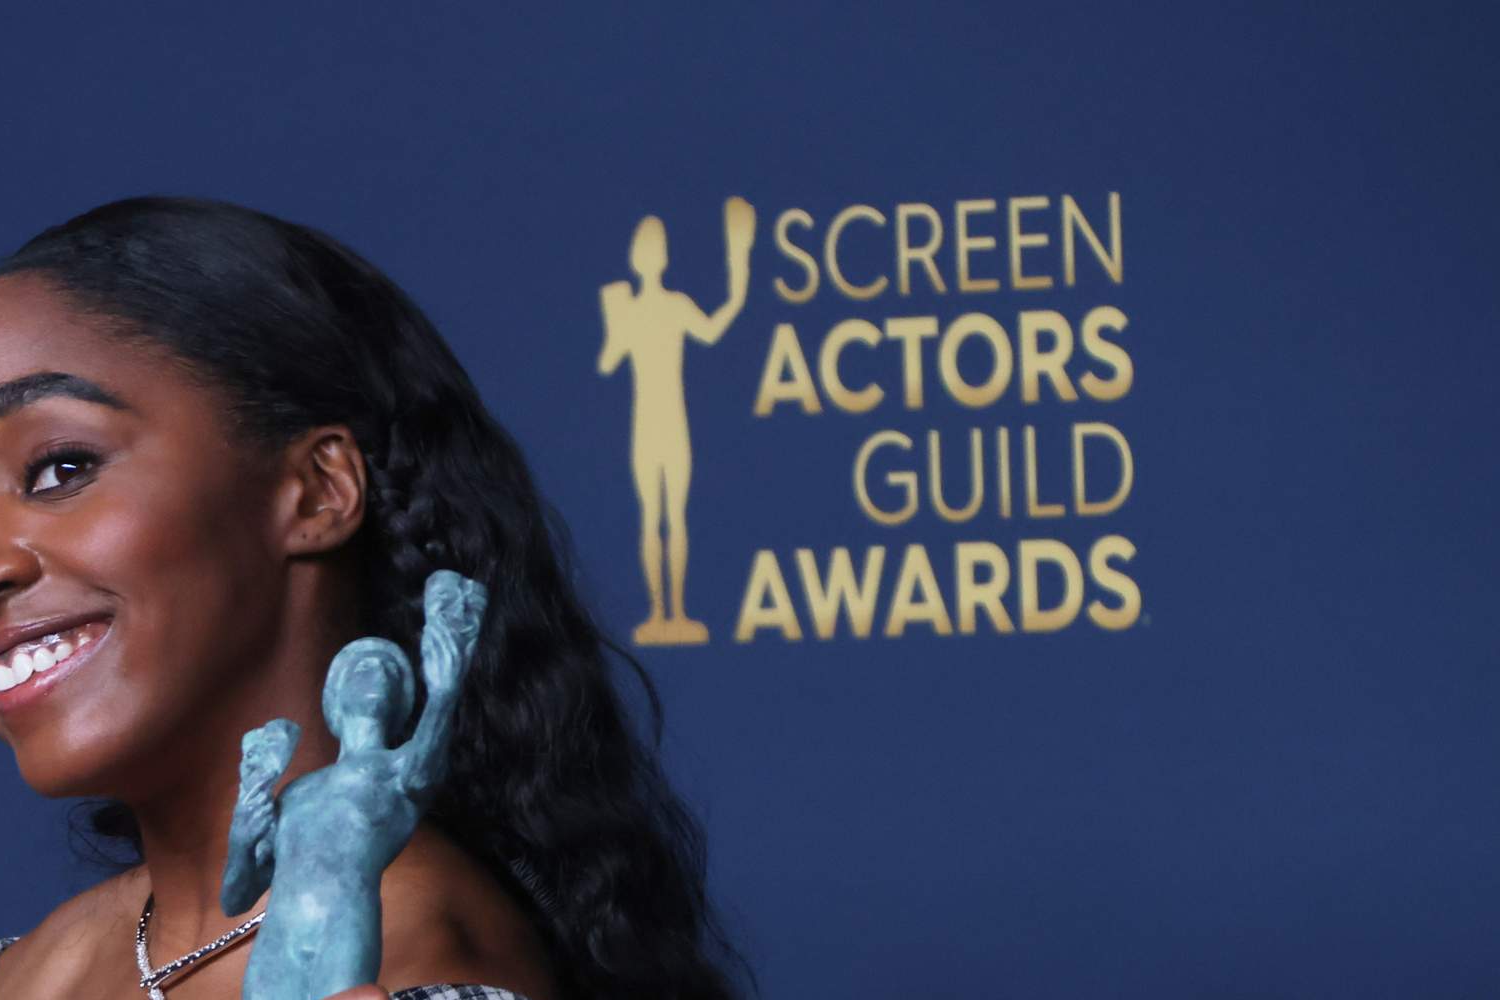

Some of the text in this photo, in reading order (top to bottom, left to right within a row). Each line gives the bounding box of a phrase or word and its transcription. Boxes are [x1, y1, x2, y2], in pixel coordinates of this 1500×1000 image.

[773, 192, 1124, 304] SCREEN
[753, 305, 1135, 417] ACTORS
[853, 422, 1135, 526] GUILD
[734, 535, 1143, 643] AWARDS
